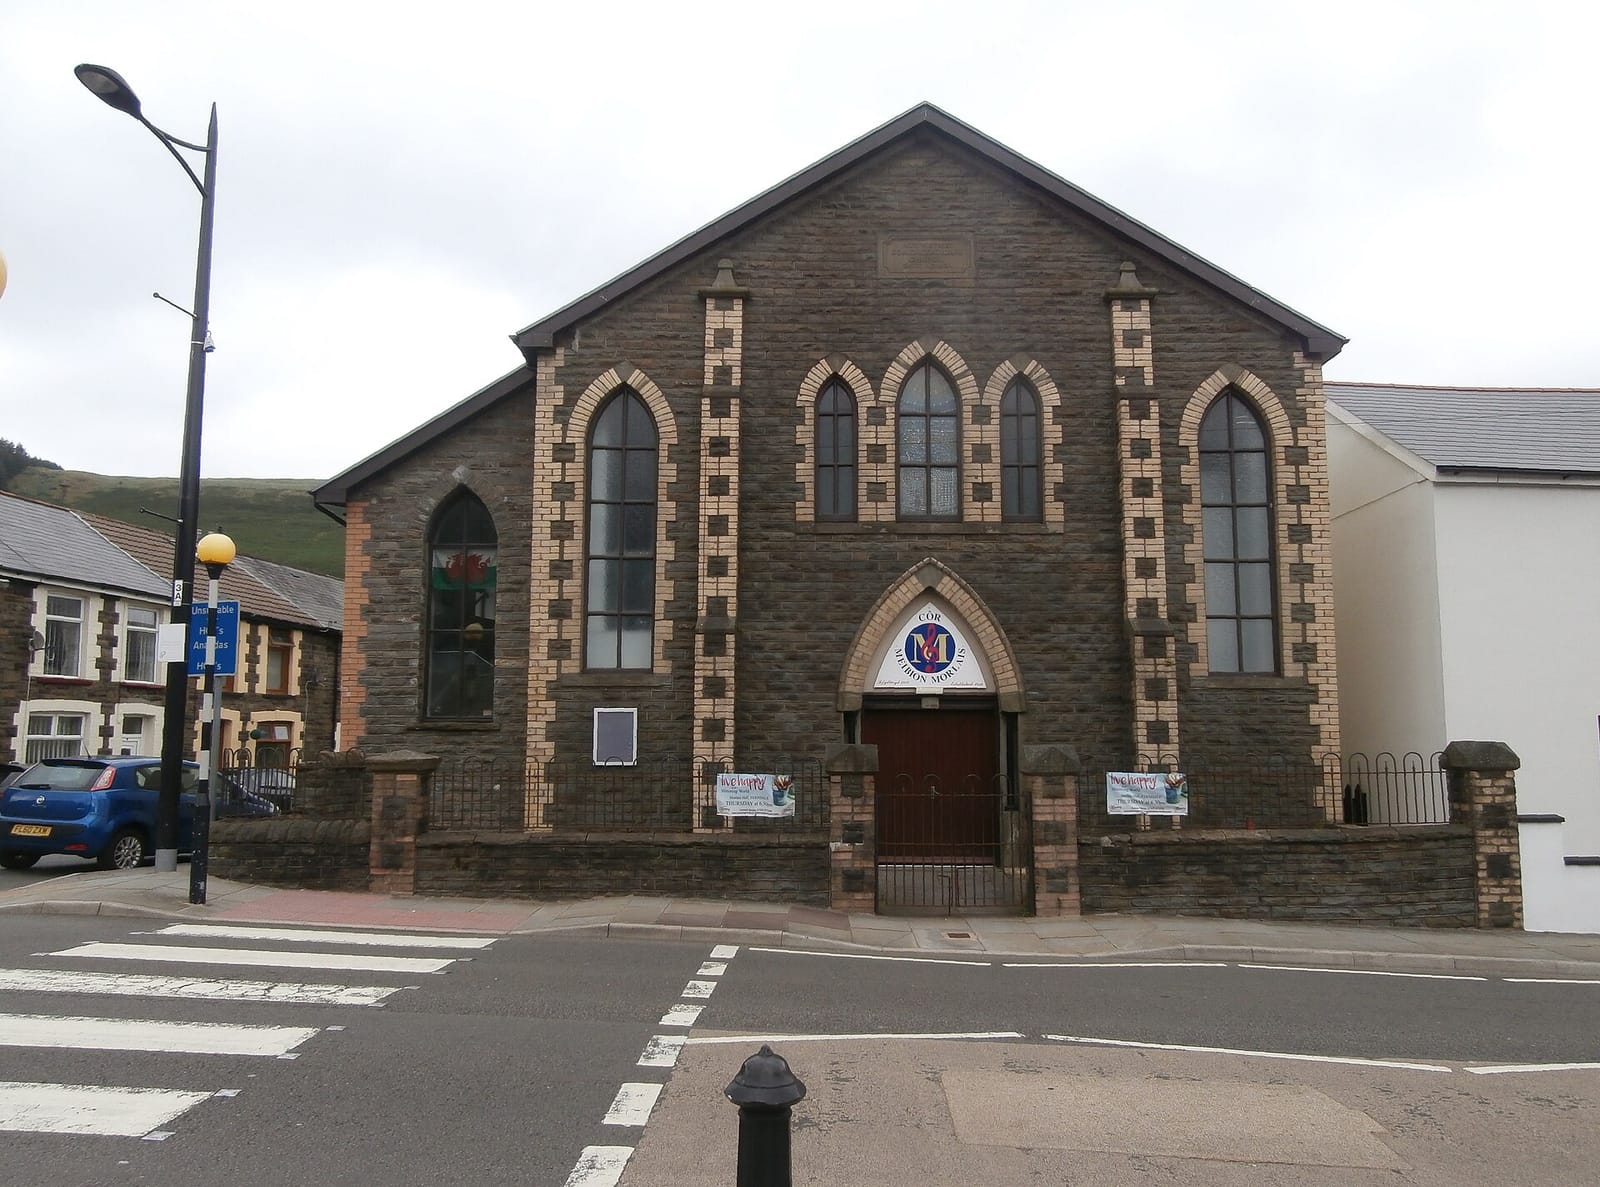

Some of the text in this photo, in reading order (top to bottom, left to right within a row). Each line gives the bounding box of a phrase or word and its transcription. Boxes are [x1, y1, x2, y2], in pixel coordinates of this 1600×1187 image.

[918, 610, 941, 622] CÔR
[894, 648, 966, 684] MEIBION MORLAIS
[721, 774, 767, 790] live happy
[1111, 773, 1157, 790] live happy
